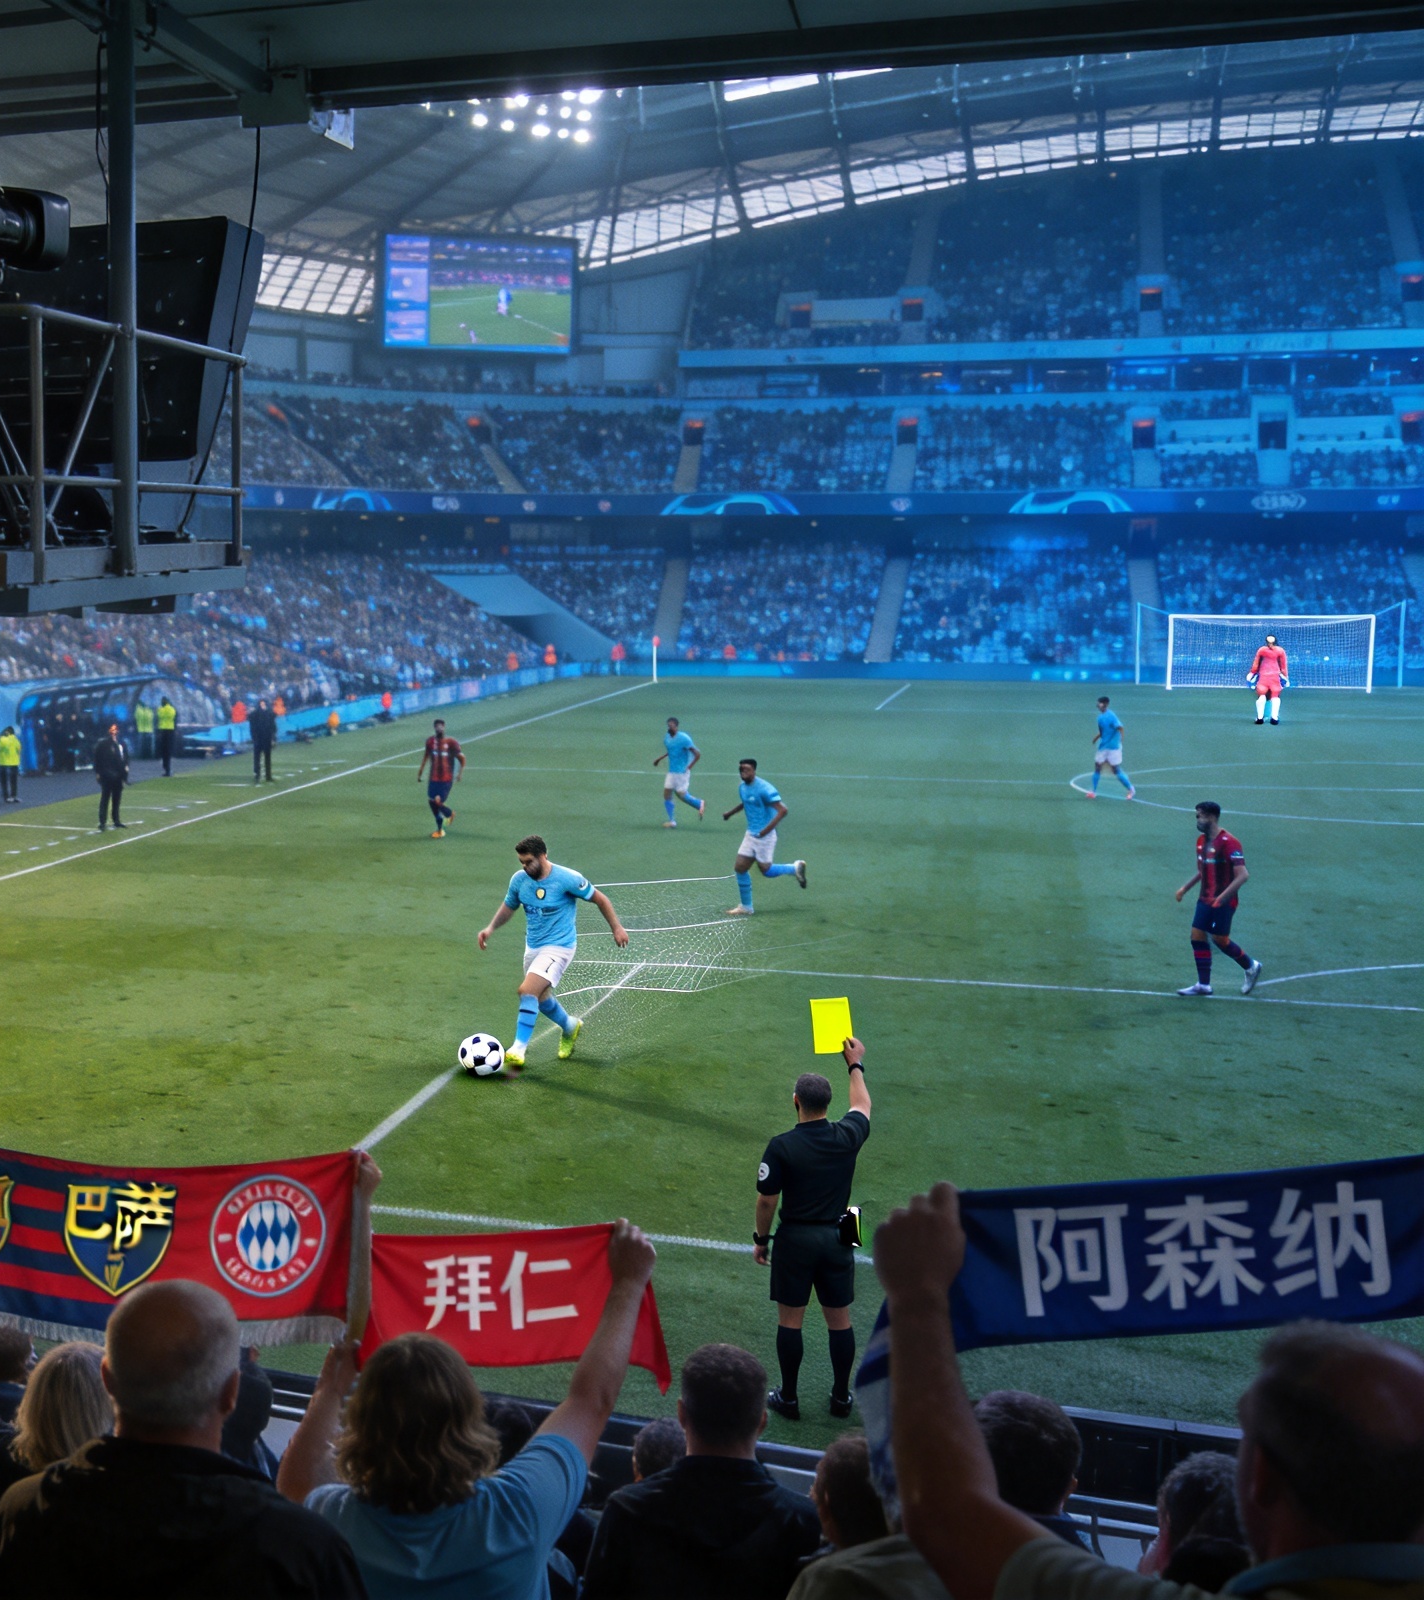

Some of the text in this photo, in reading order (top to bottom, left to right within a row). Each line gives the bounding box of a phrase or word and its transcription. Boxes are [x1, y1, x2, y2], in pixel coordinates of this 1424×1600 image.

[423, 1250, 579, 1331] 拜仁
[1014, 1180, 1393, 1318] 阿森纳
